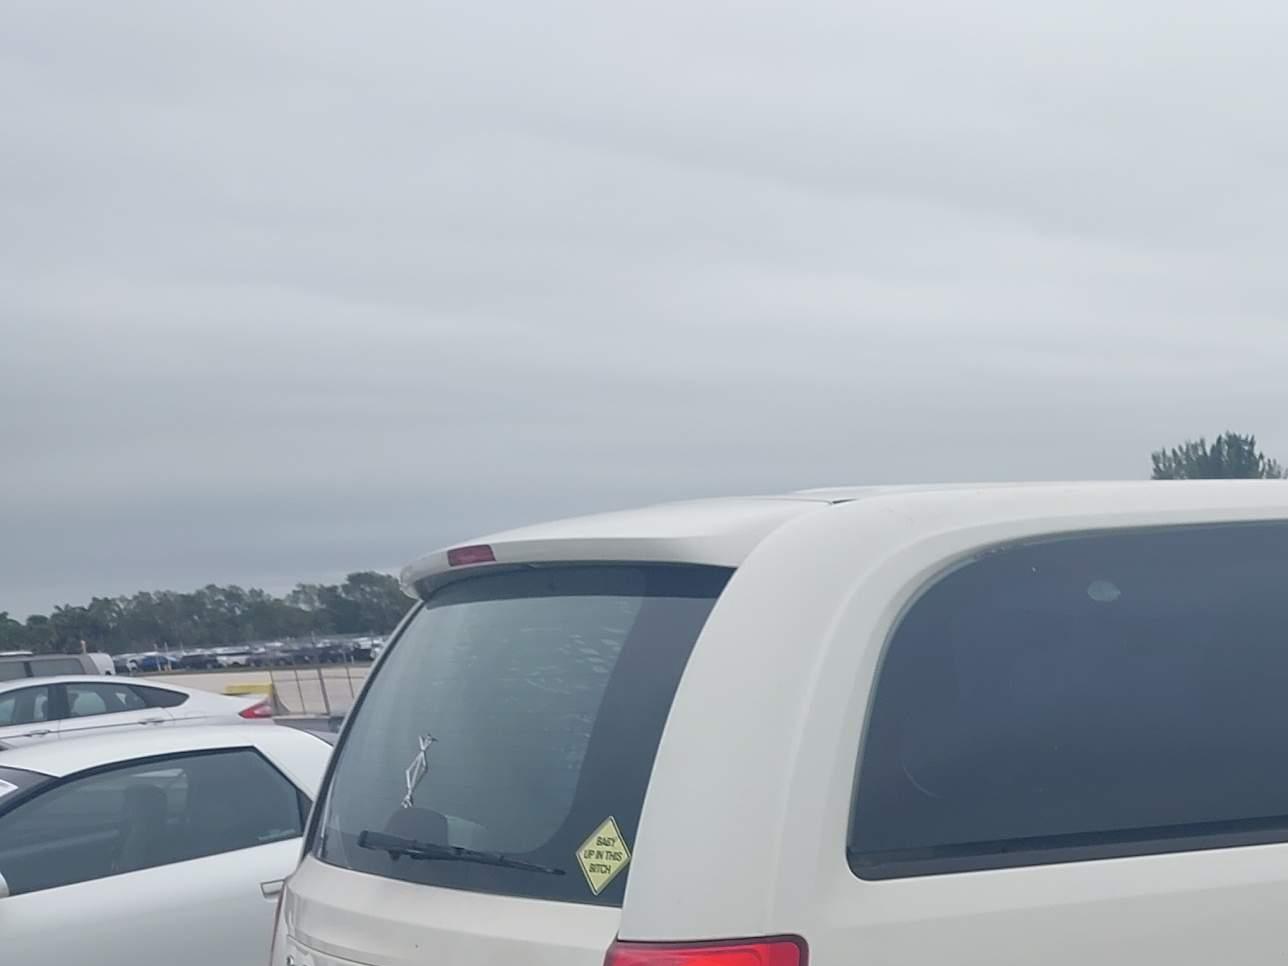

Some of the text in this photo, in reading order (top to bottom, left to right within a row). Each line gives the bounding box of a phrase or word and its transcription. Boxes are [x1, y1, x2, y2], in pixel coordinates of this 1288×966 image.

[583, 850, 622, 862] UP IN THIS
[589, 863, 611, 874] BITCH
